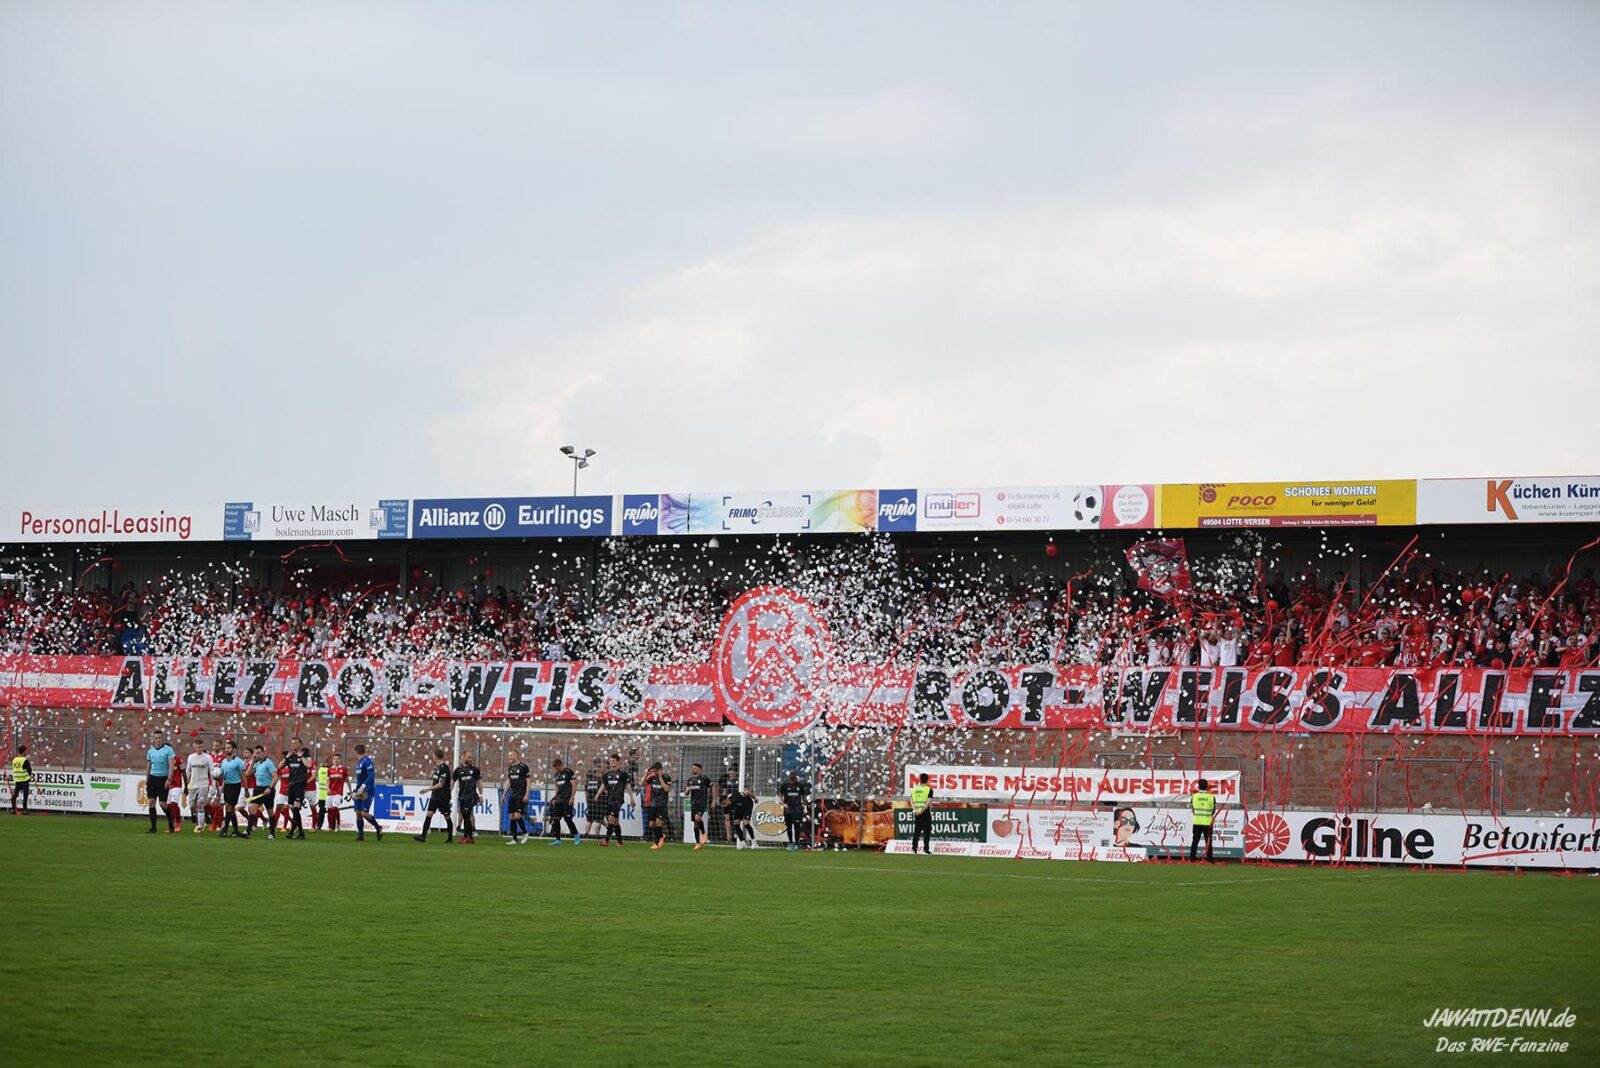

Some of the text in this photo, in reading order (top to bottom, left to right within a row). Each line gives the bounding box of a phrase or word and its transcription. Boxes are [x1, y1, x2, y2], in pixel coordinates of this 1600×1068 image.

[1284, 484, 1376, 497] SCHÖNES WOHNEN
[929, 499, 975, 510] müller
[1227, 496, 1276, 506] POCO
[1323, 500, 1354, 509] weniger
[1356, 499, 1377, 507] Geld!
[1487, 480, 1600, 520] Küchen Küm
[271, 505, 305, 522] Uwe
[310, 504, 359, 522] Masch
[419, 504, 605, 529] Allianz Eurlings
[623, 507, 658, 521] FRIMO
[729, 506, 804, 518] FRIMO STADION
[879, 503, 915, 517] FRIMO
[21, 510, 191, 539] Personal-Leasing
[1222, 518, 1271, 526] LOTTE-WERSEN
[275, 527, 354, 537] bodenundraum.com
[110, 656, 1600, 732] ALLEZ ROT-WEISS ROT-WEISS ALLEZ
[30, 773, 84, 785] BERISHA
[909, 773, 998, 791] MEISTER
[1003, 775, 1092, 793] MÜSSEN
[37, 788, 76, 797] Marken
[1301, 817, 1435, 860] Gilne
[933, 846, 967, 854] BECKHOFF
